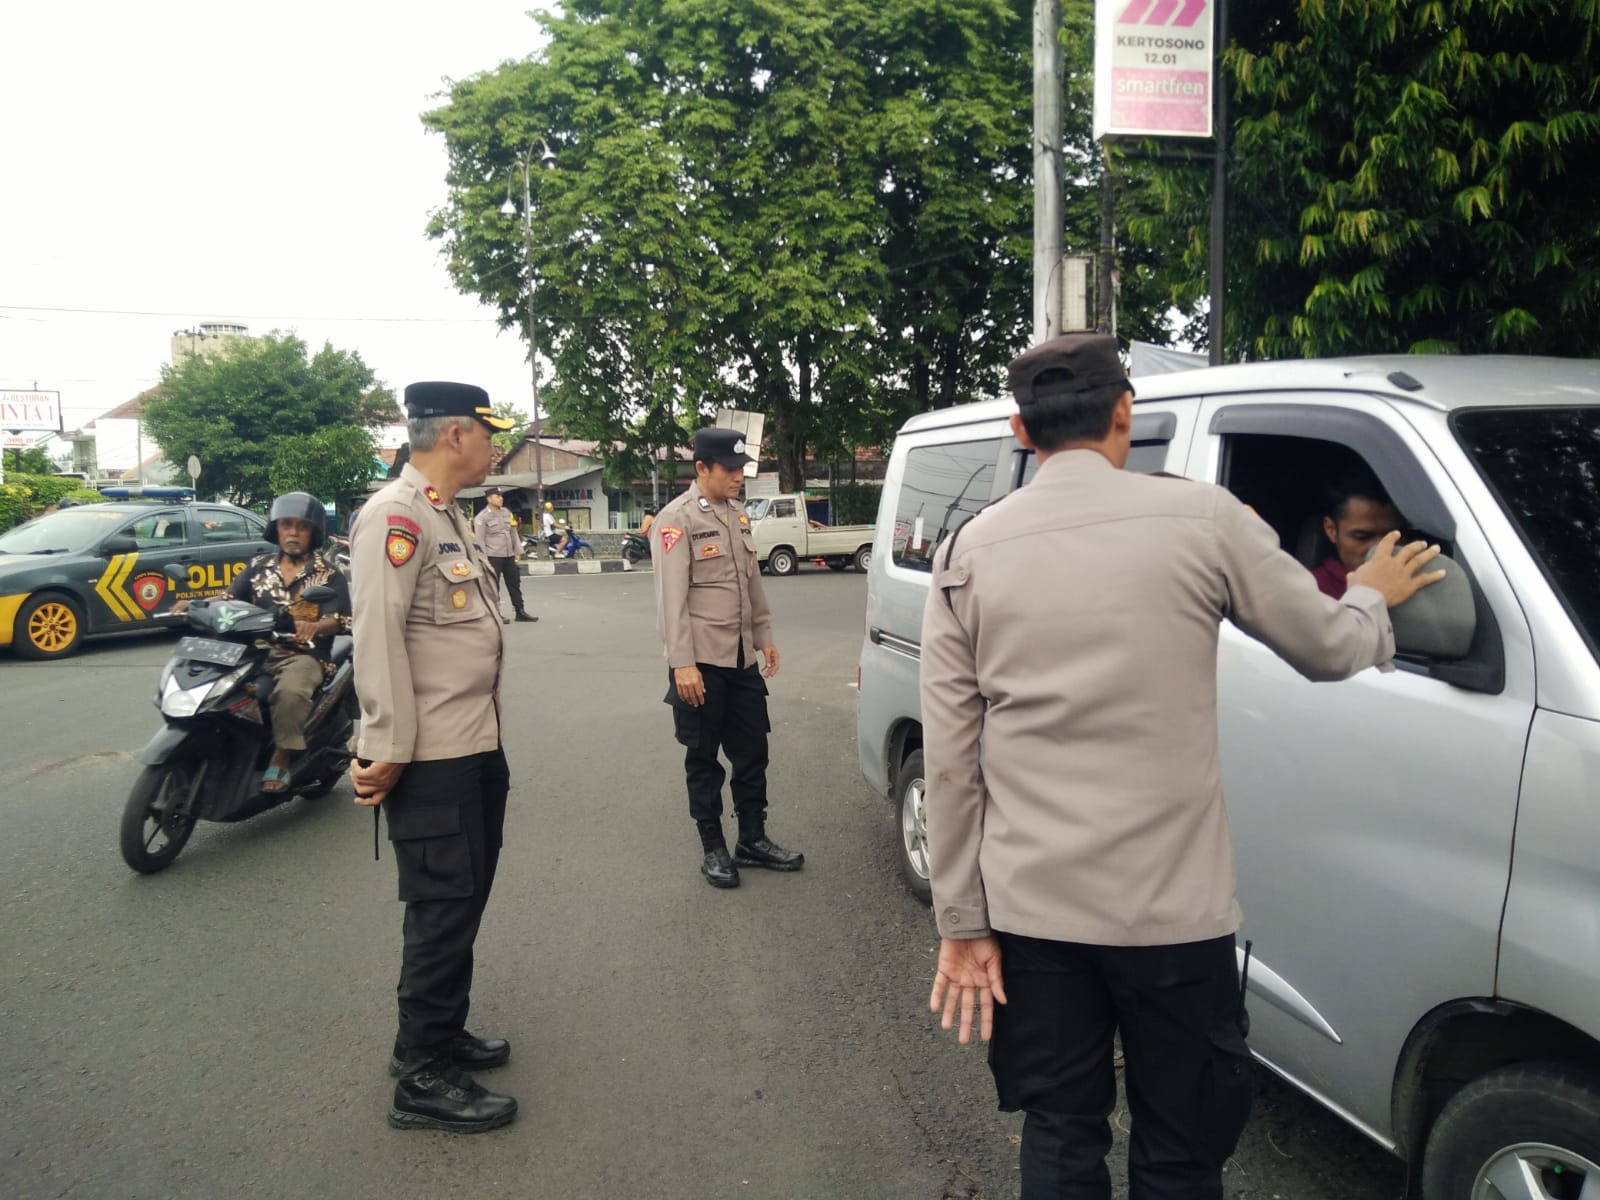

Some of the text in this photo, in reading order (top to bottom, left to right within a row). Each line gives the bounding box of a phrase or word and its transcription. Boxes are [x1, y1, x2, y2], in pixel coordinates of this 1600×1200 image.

[1117, 35, 1205, 50] KERTOSONO
[1144, 53, 1177, 65] 12.01
[1117, 77, 1205, 96] smartfren
